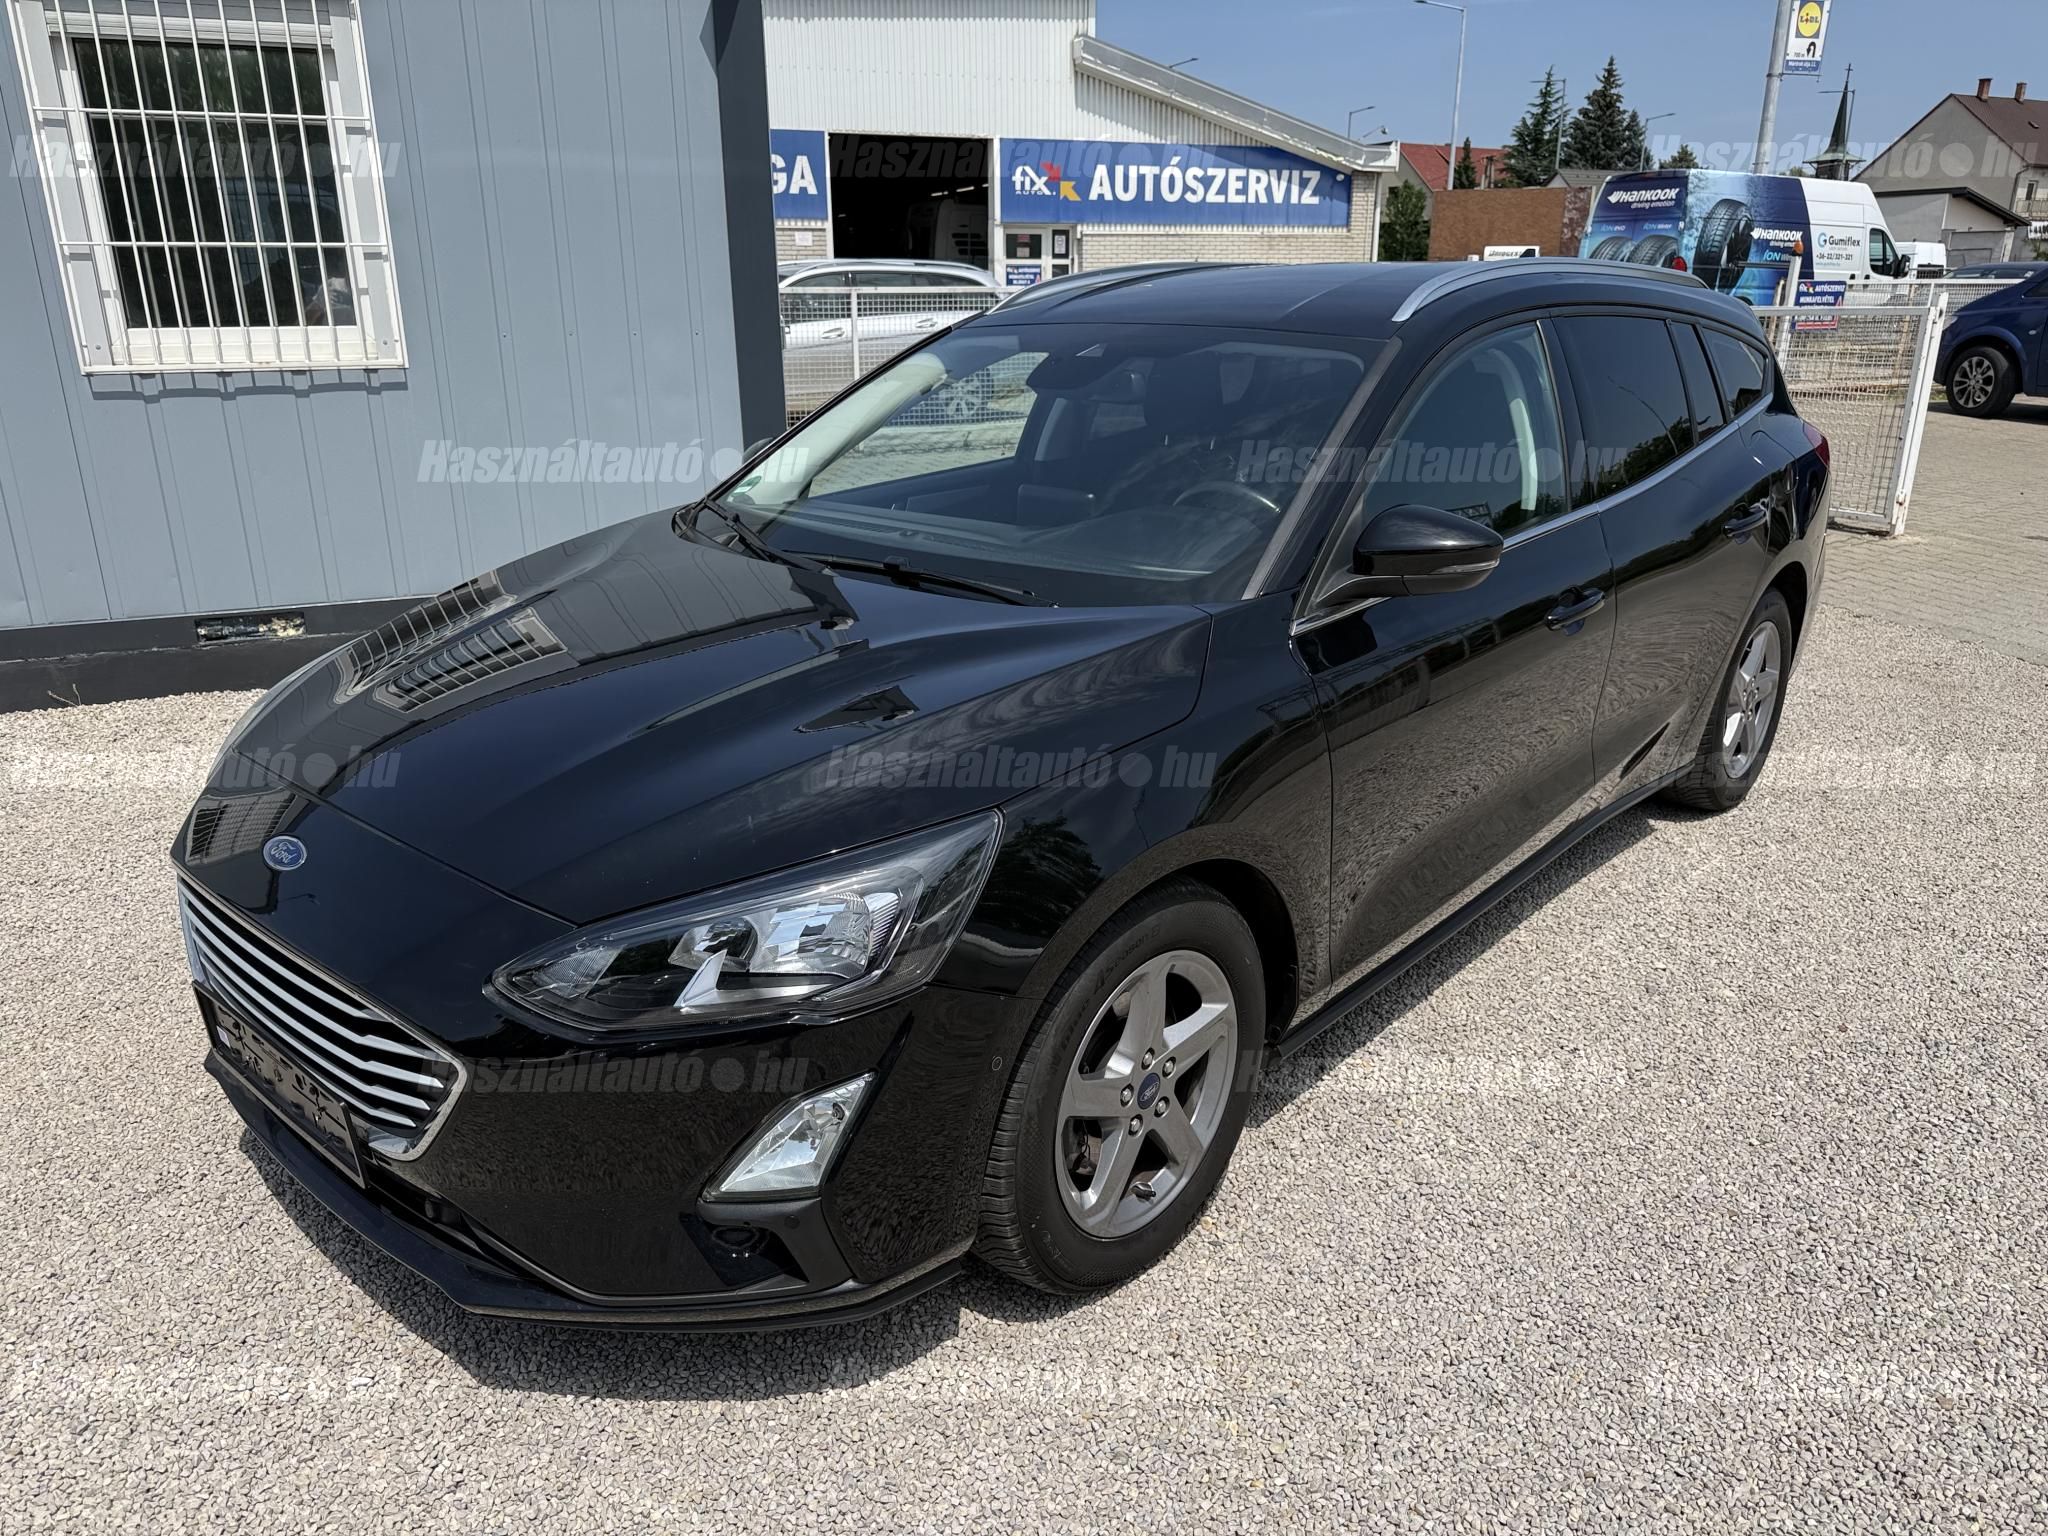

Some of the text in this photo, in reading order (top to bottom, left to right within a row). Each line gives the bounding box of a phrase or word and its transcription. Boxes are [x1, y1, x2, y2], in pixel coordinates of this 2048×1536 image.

[1088, 156, 1321, 205] AUTÓSZERVIZ
[1828, 235, 1861, 247] Gumiflex
[1814, 284, 1846, 293] AUTÓSZERVIZ
